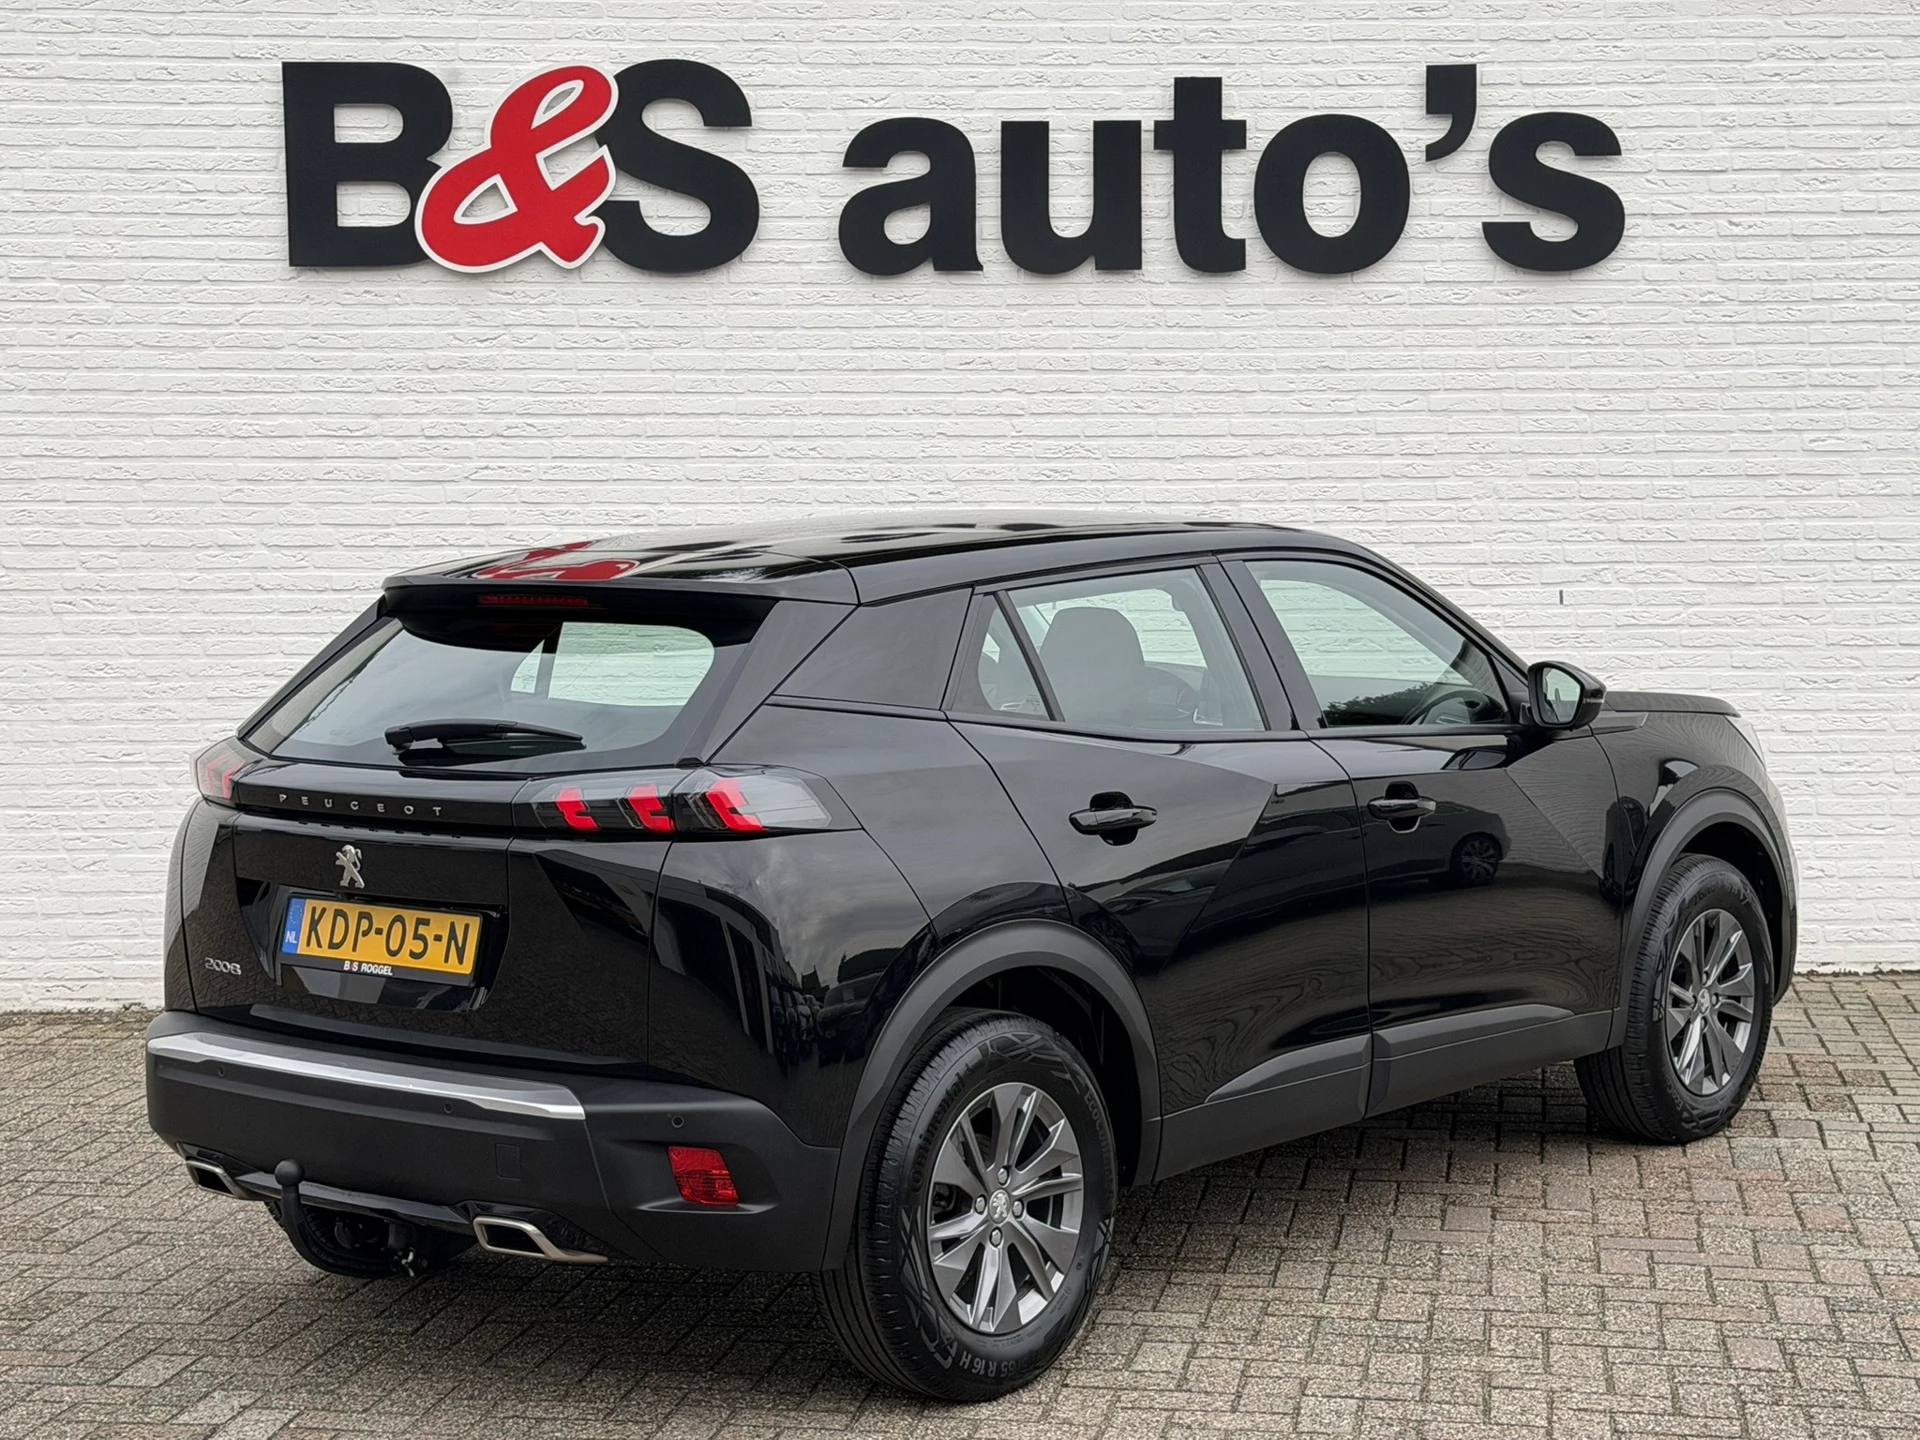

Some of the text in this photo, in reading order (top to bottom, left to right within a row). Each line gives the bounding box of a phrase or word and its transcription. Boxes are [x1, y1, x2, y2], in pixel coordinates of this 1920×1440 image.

[282, 59, 1626, 275] B&S auto's
[278, 793, 442, 817] PEUGEOT
[284, 930, 298, 945] NL
[305, 905, 471, 966] KDP-05-N
[204, 957, 242, 975] 2008
[361, 963, 394, 976] ROGGEL
